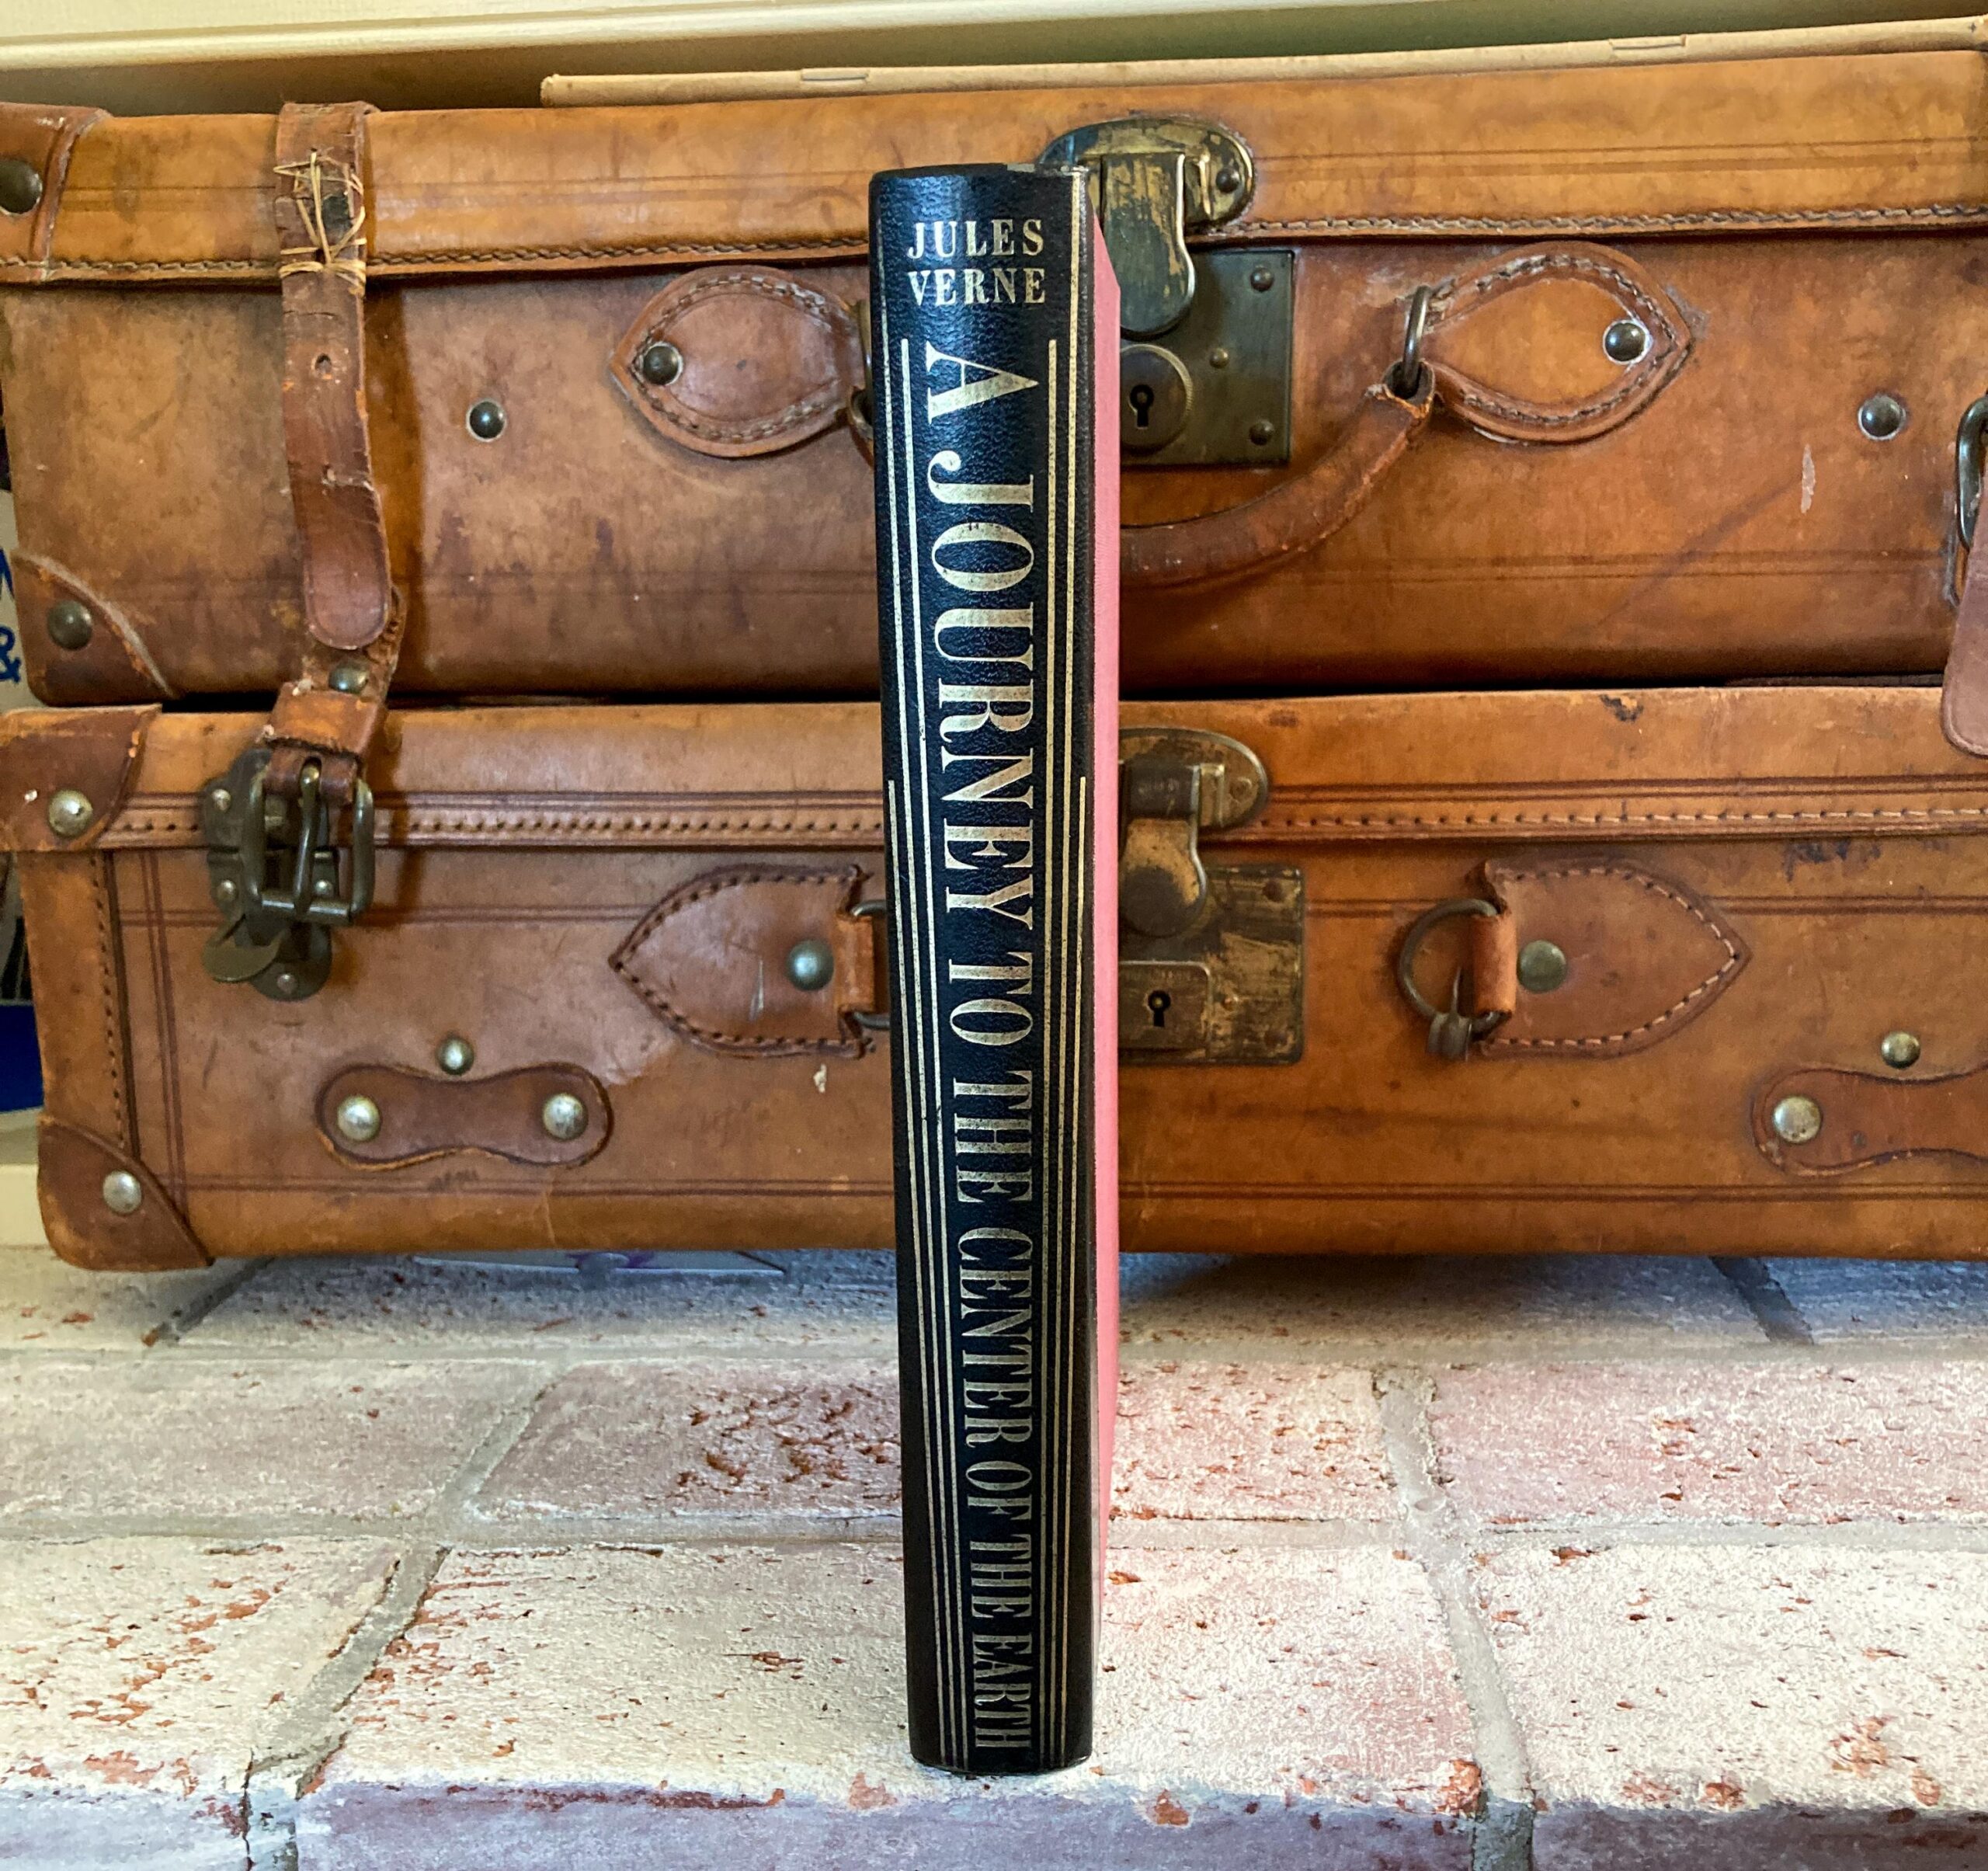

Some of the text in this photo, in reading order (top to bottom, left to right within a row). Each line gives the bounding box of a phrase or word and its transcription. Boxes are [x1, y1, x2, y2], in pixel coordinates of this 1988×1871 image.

[907, 218, 1044, 259] JULES
[907, 268, 1046, 306] VERNE
[926, 341, 1039, 1748] A JOURNEY TO THE CENTER OF THE EARTH
